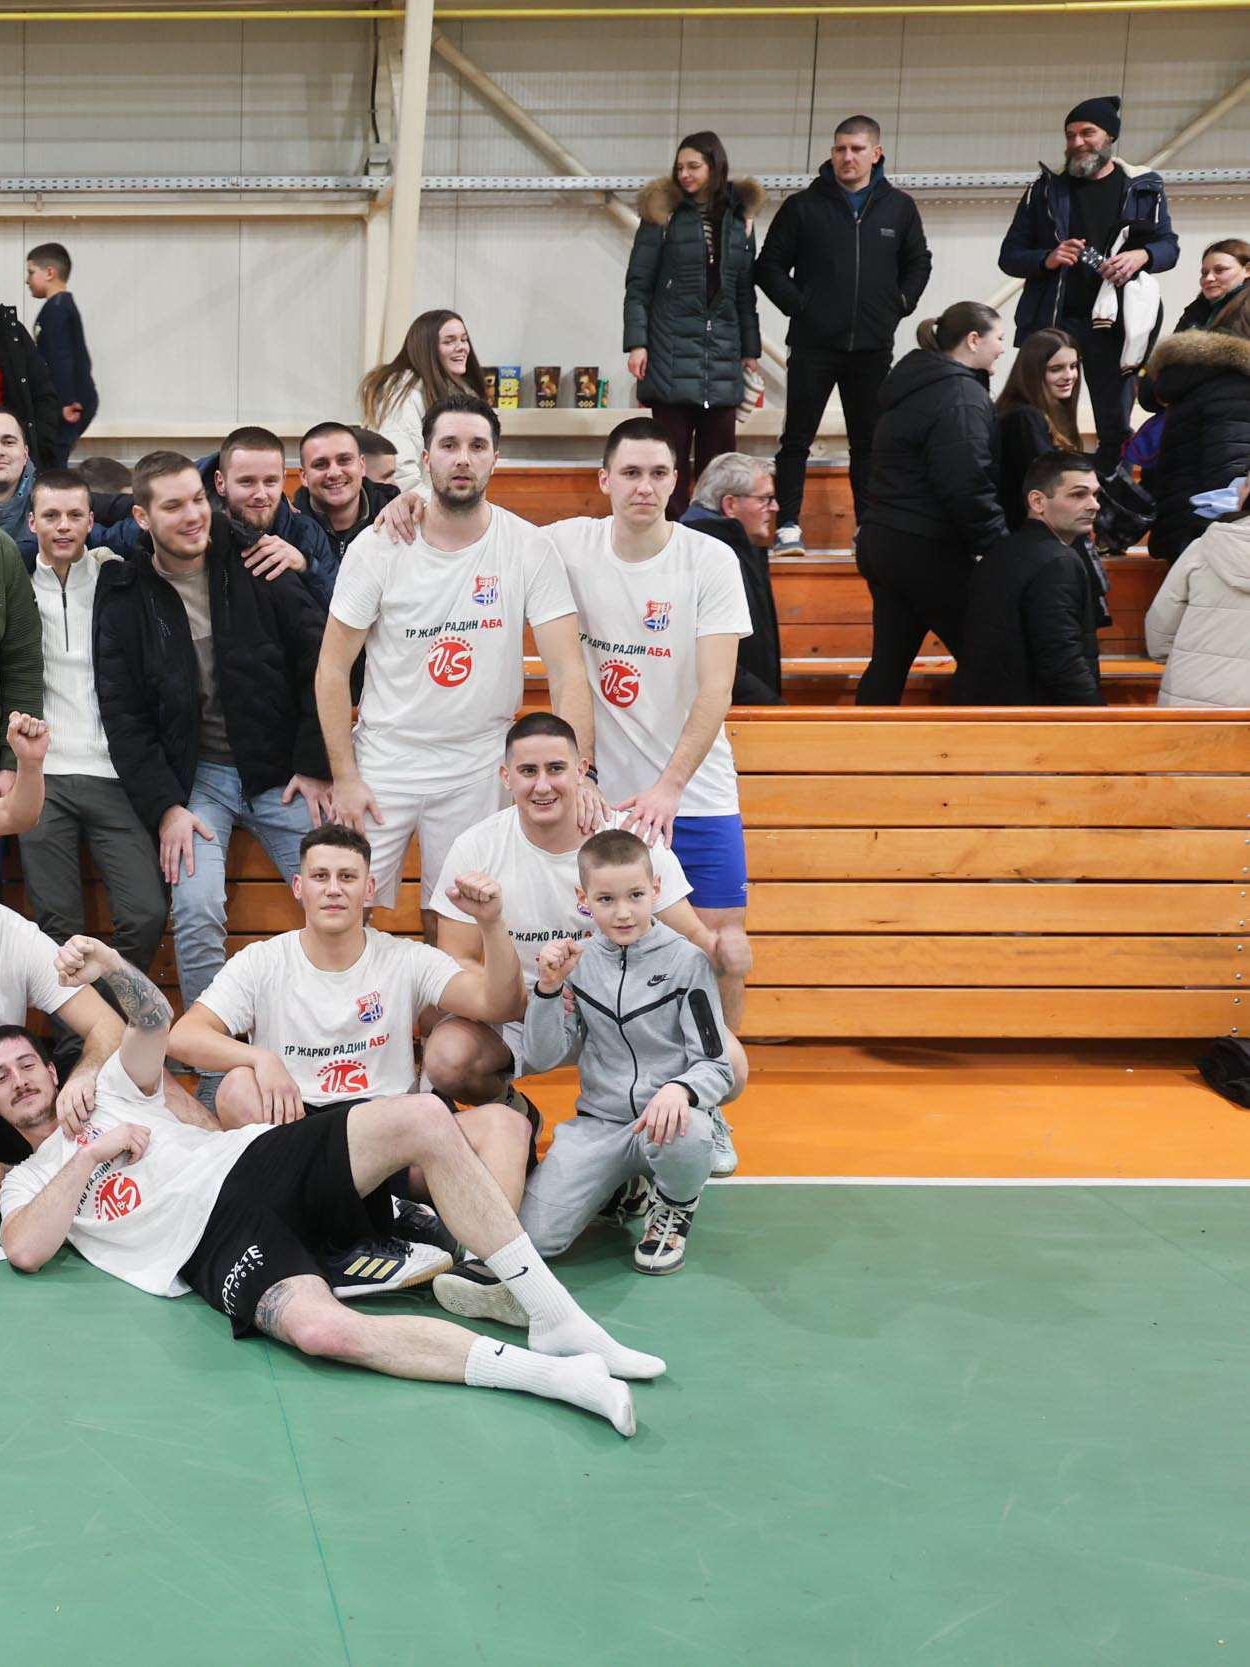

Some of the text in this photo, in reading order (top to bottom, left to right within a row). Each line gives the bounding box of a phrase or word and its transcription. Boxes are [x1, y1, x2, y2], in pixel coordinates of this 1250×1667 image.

[406, 629, 416, 638] ТР
[444, 620, 478, 632] РАДИН
[480, 618, 503, 629] АБА
[613, 643, 646, 655] РАДИН
[647, 647, 672, 657] АБА
[428, 646, 471, 682] V&S
[599, 667, 639, 703] V&S
[515, 931, 550, 942] ЖАРКО
[284, 1046, 295, 1056] ТР
[297, 1046, 330, 1058] ЖАРКО
[332, 1040, 367, 1056] РАДИН
